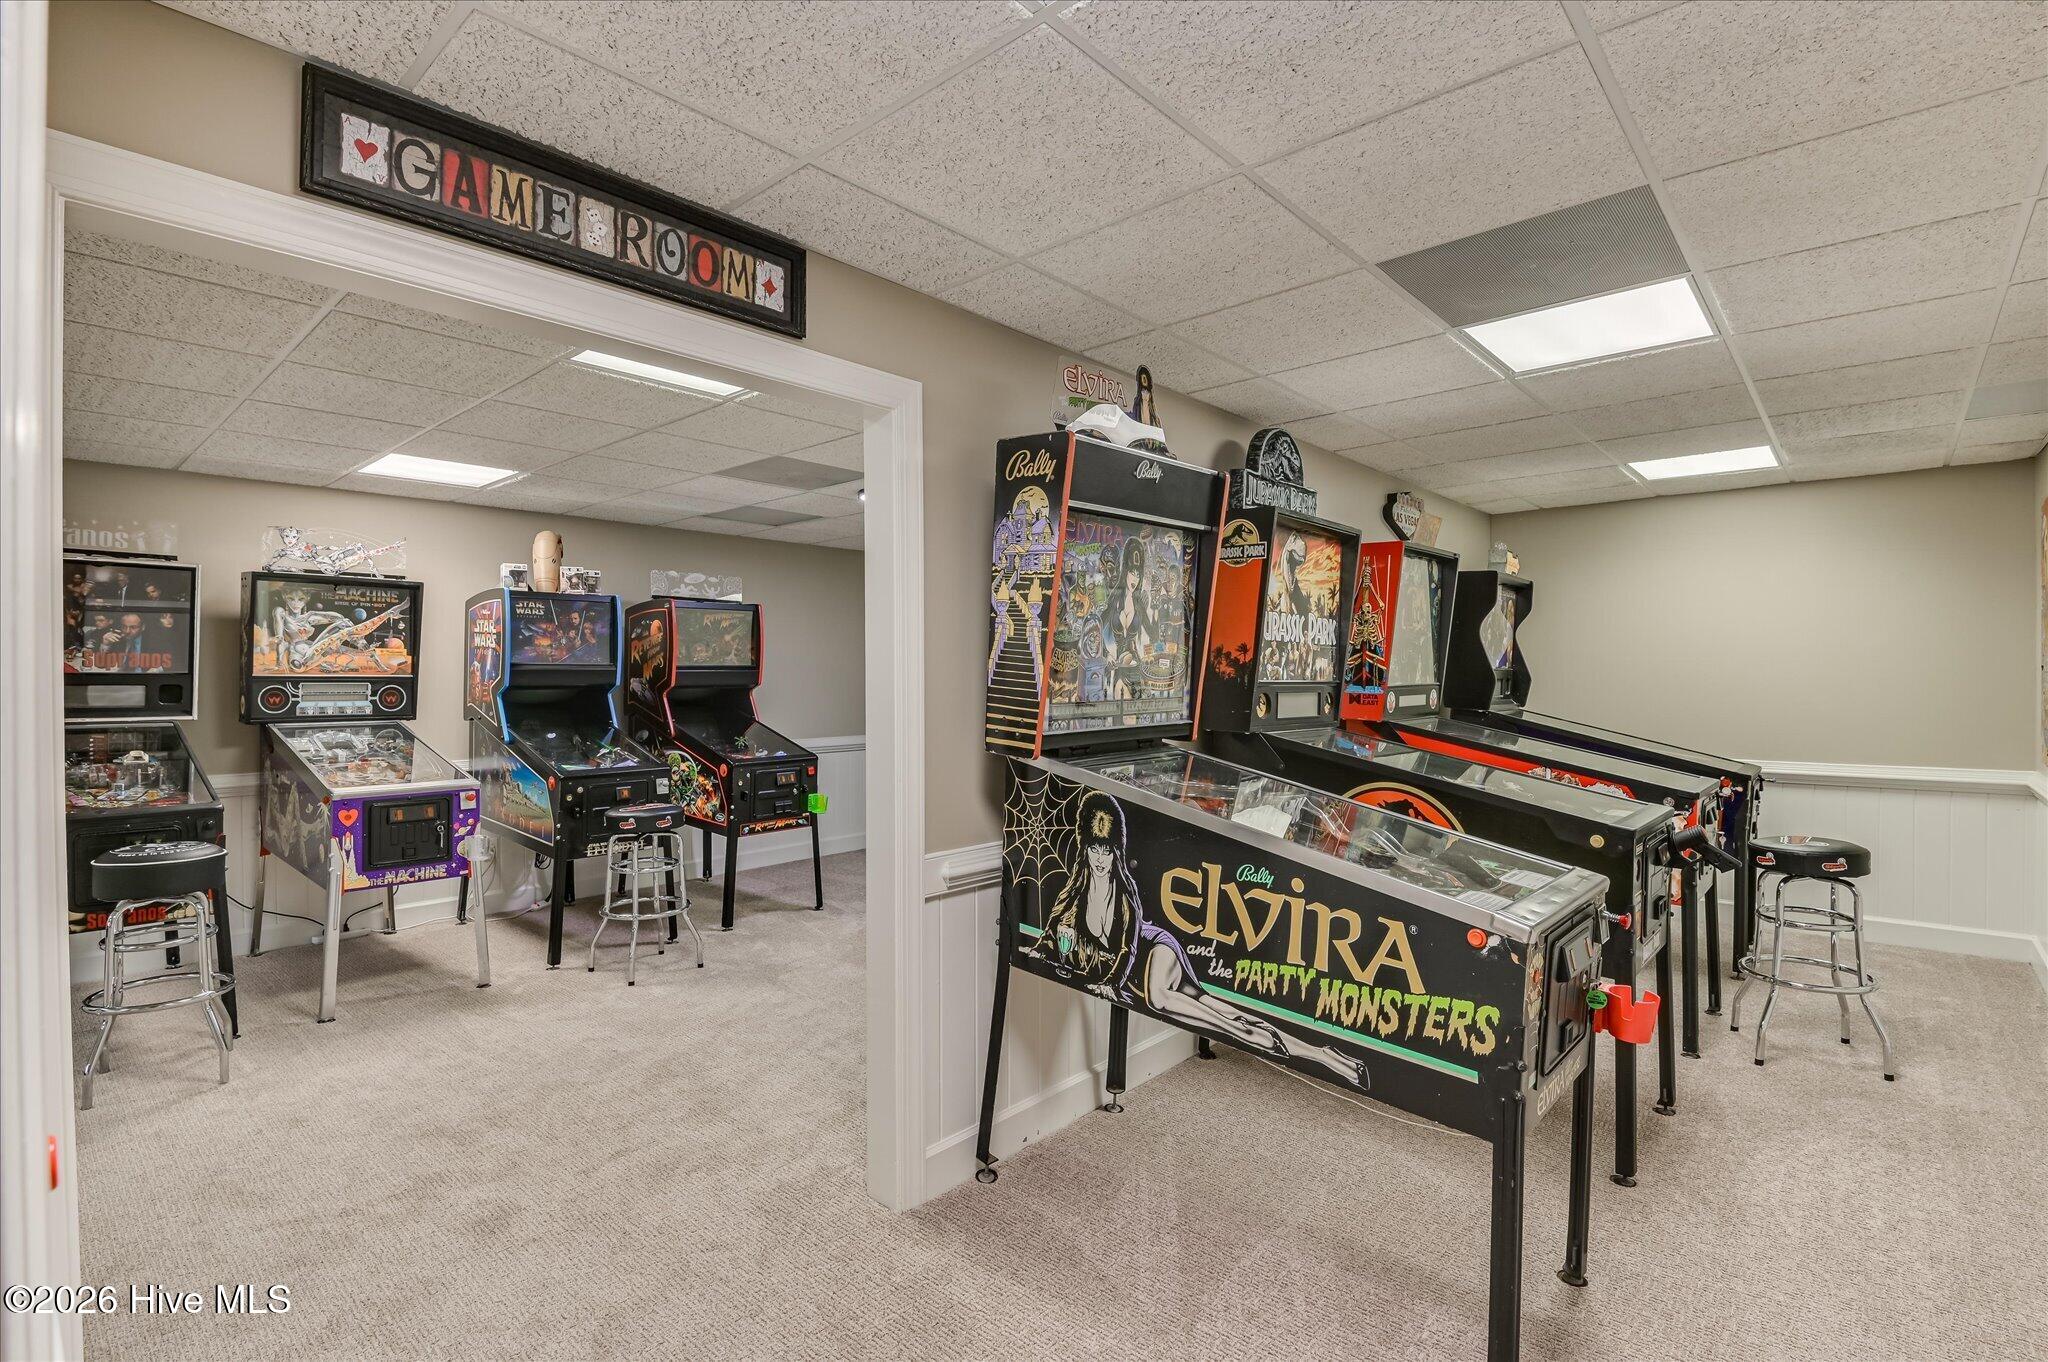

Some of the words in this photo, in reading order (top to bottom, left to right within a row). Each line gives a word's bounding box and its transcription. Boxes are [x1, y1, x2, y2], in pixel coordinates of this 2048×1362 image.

[393, 137, 573, 241] GAME
[620, 210, 751, 300] ROOM
[1006, 449, 1057, 483] Bally
[1136, 460, 1162, 483] Bally
[1220, 545, 1243, 559] RASSIC
[1244, 544, 1265, 558] PARK
[335, 585, 399, 602] MACHINE
[515, 600, 545, 609] STAR
[515, 607, 545, 616] WARS
[474, 619, 497, 633] STAR
[1264, 611, 1305, 642] URASSIC
[1308, 612, 1337, 646] PARK
[474, 633, 497, 648] WARS
[384, 863, 448, 884] MACHINE
[1236, 863, 1275, 887] Bally
[1186, 939, 1216, 958] and
[1208, 955, 1234, 979] the
[1234, 959, 1317, 1002] PARTY
[1313, 978, 1500, 1057] MONSTERS
